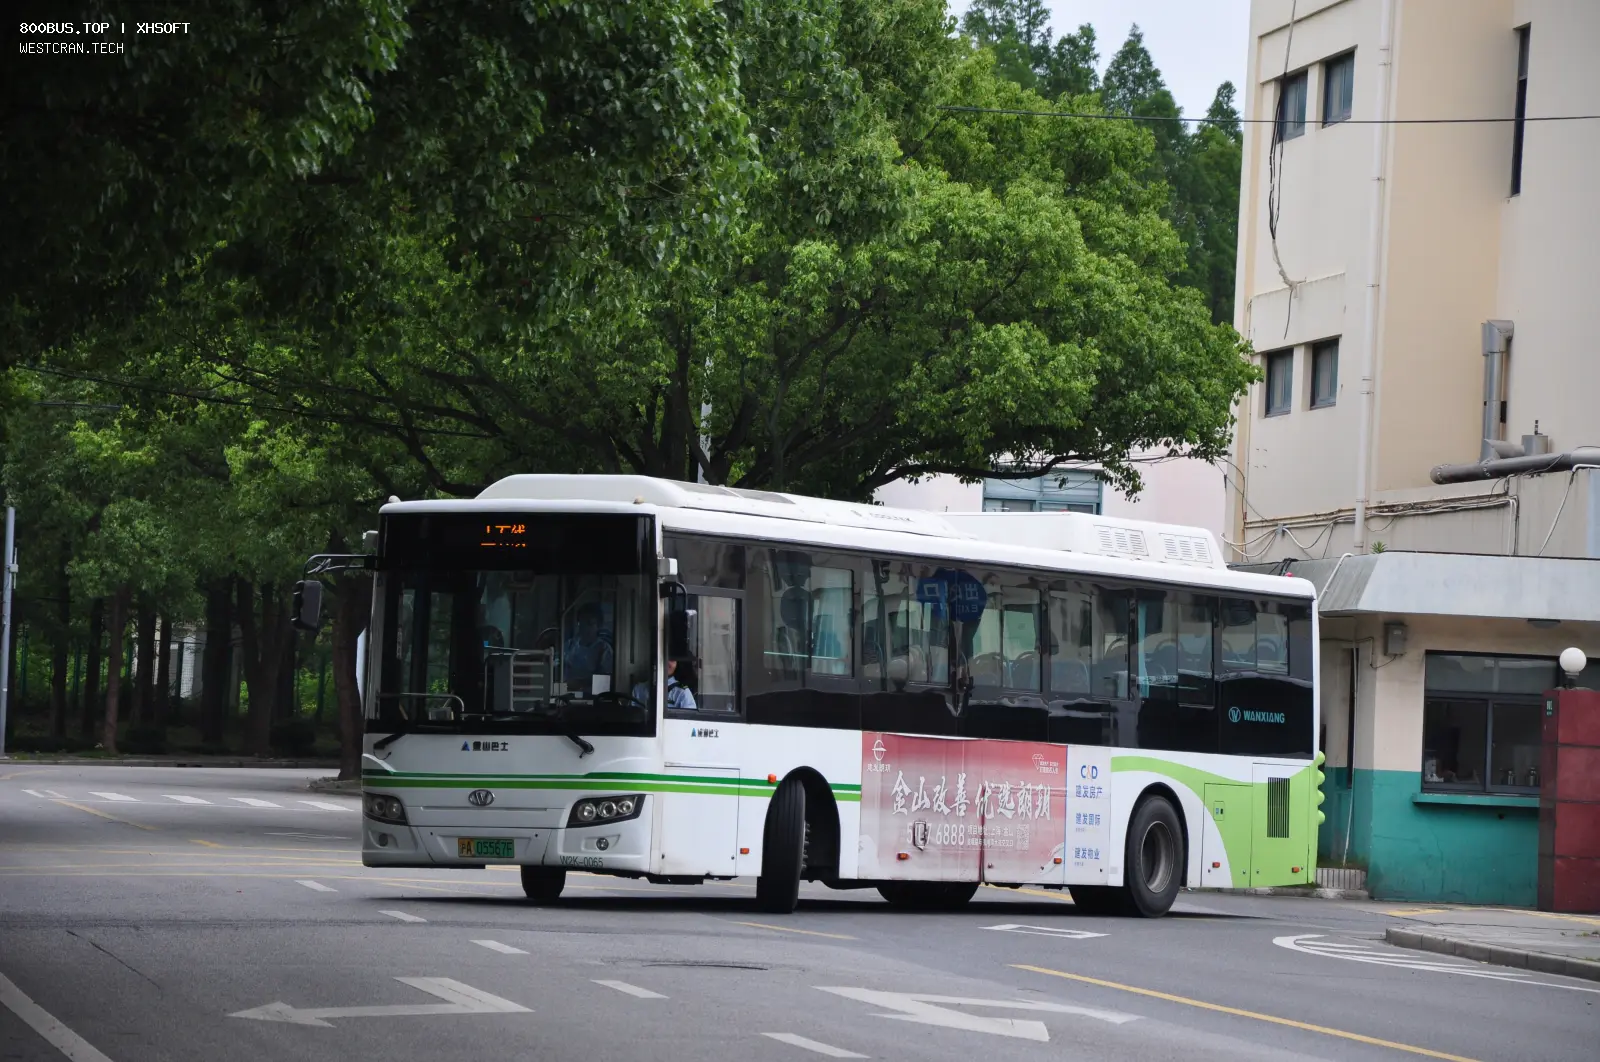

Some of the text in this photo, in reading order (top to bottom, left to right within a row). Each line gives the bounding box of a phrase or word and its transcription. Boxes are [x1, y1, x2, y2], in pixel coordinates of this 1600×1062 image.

[1243, 709, 1286, 724] WANXIANG
[1075, 784, 1103, 799] 建发房产
[935, 823, 965, 846] 6888
[1074, 847, 1101, 860] 建发物业
[559, 855, 604, 868] W2K-0065
